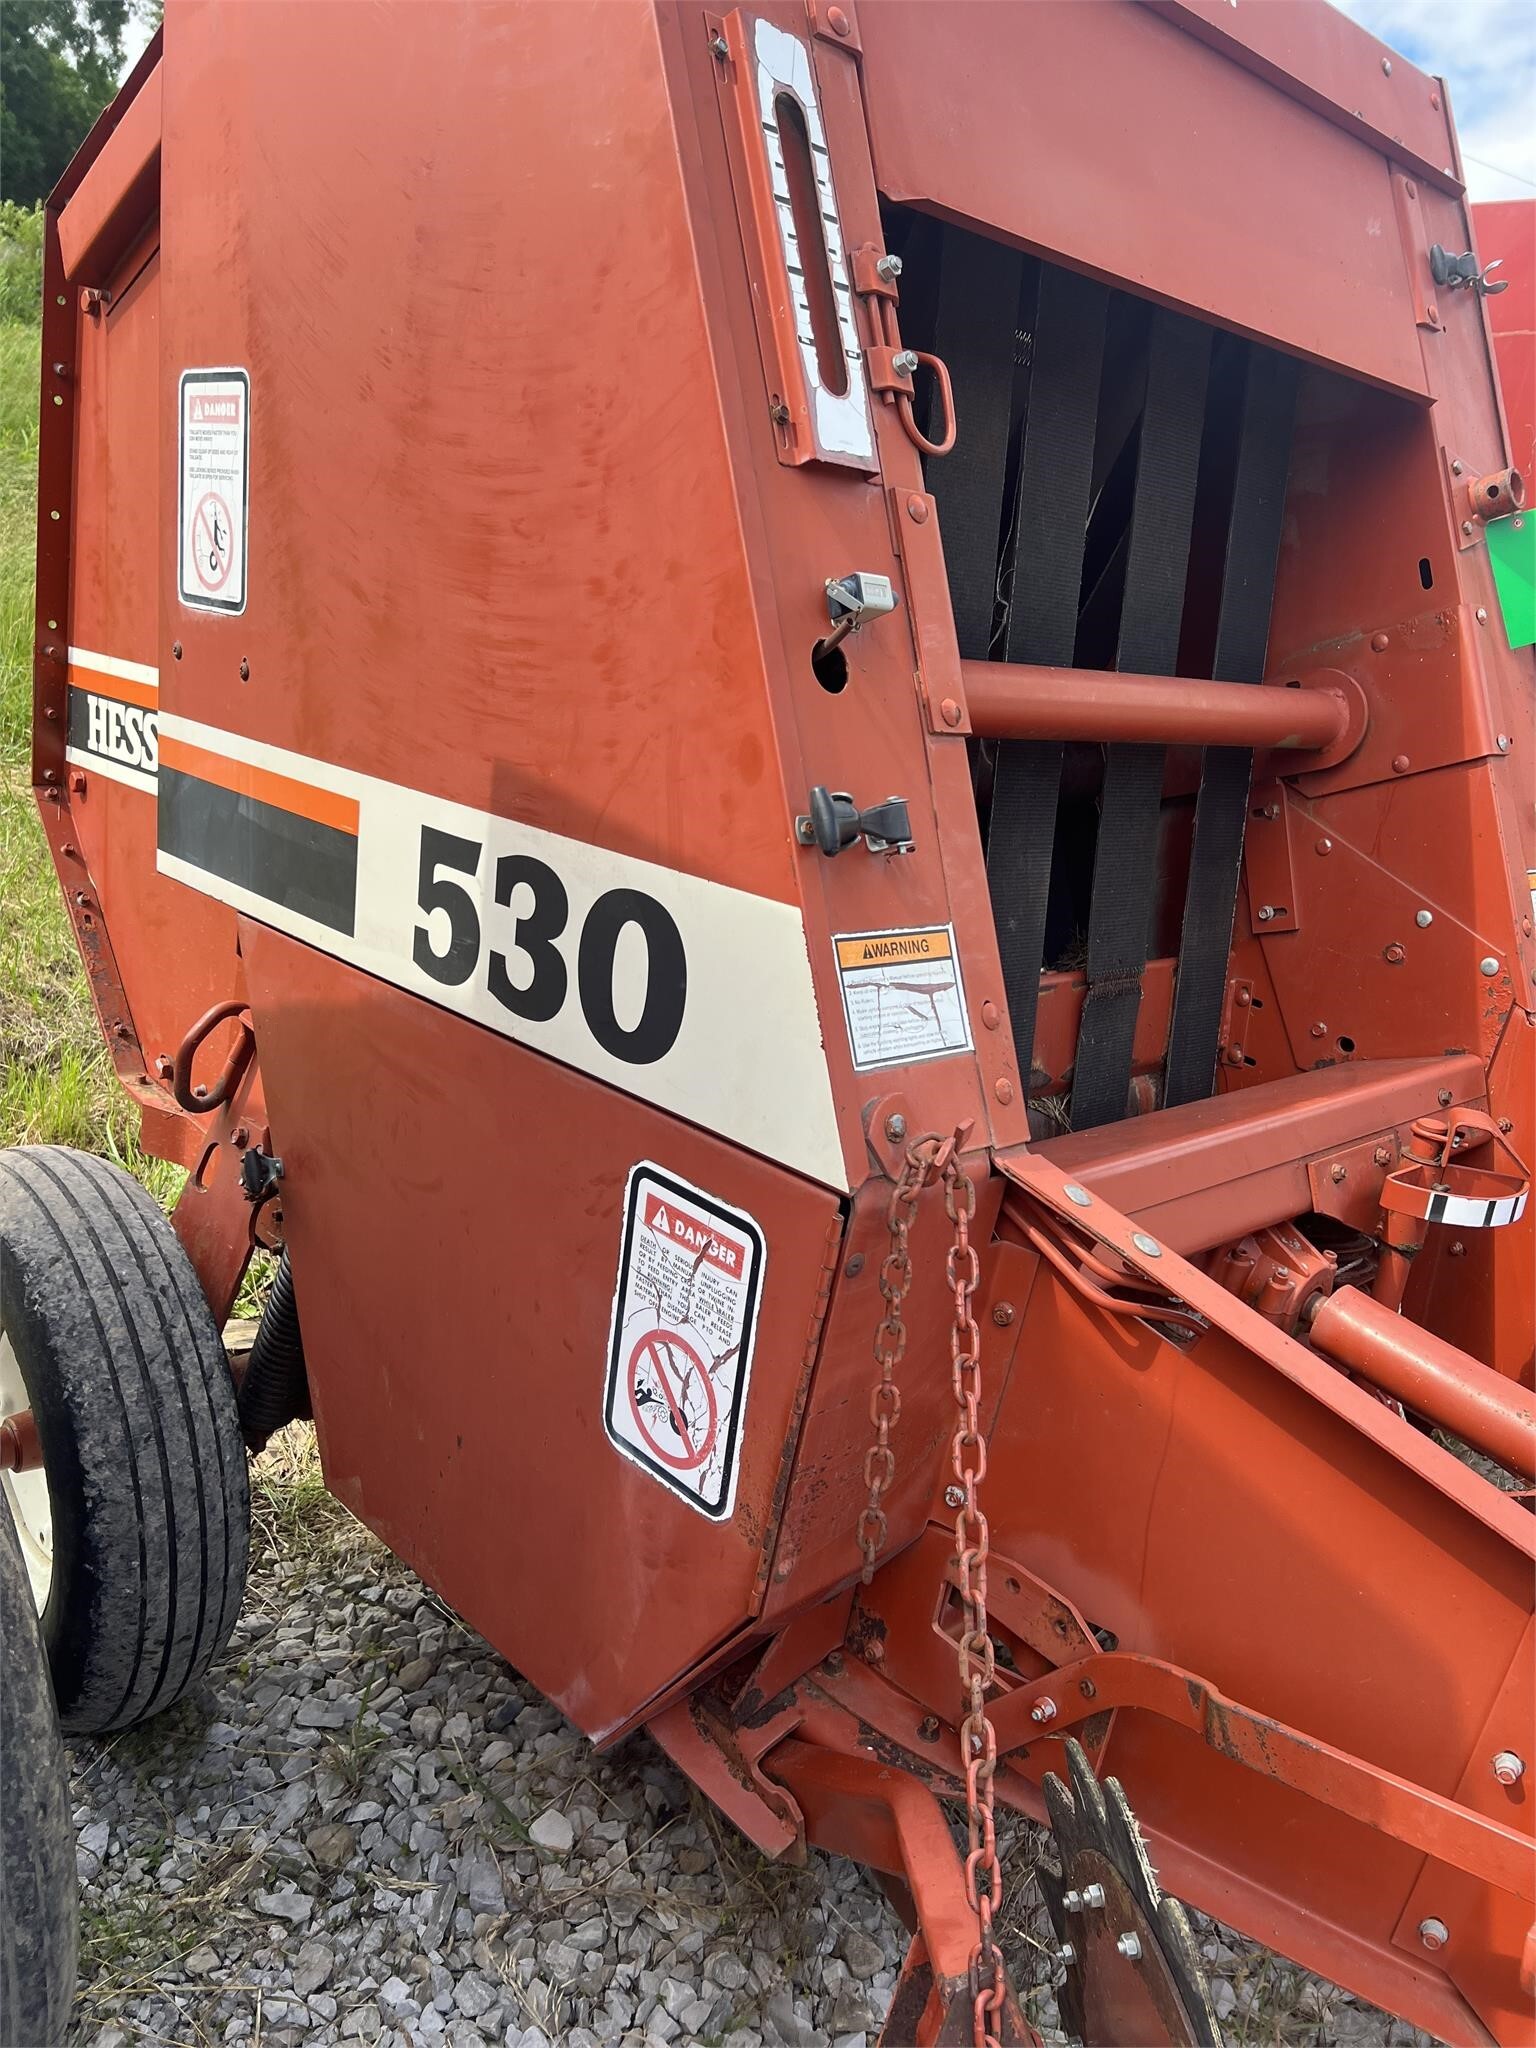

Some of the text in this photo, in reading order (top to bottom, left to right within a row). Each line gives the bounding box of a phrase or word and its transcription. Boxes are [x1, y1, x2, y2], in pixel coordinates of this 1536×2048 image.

[87, 693, 158, 772] HESS
[413, 824, 687, 1065] 530
[871, 938, 930, 958] WARNING
[640, 1235, 738, 1298] DEATH OR SERIOU INJURY CAN
[674, 1219, 737, 1269] DANGER
[634, 1289, 647, 1301] SHUT
[638, 1250, 646, 1258] OR
[648, 1256, 655, 1264] BY
[657, 1261, 679, 1279] FEEDING
[697, 1287, 706, 1295] OR
[708, 1293, 725, 1307] TWINE
[638, 1258, 645, 1266] TO
[647, 1264, 660, 1275] FEED
[662, 1273, 679, 1287] ENTRY
[699, 1297, 714, 1311] WHILE
[718, 1307, 734, 1321] BALER
[639, 1243, 657, 1256] RESULT
[700, 1280, 737, 1306] UNPLUGGING
[635, 1274, 732, 1339] FASTER THAN YOU CAN RELEASE
[695, 1303, 711, 1317] BALER
[717, 1316, 733, 1331] FEEDS
[702, 1324, 714, 1336] PTO
[718, 1335, 731, 1347] AND
